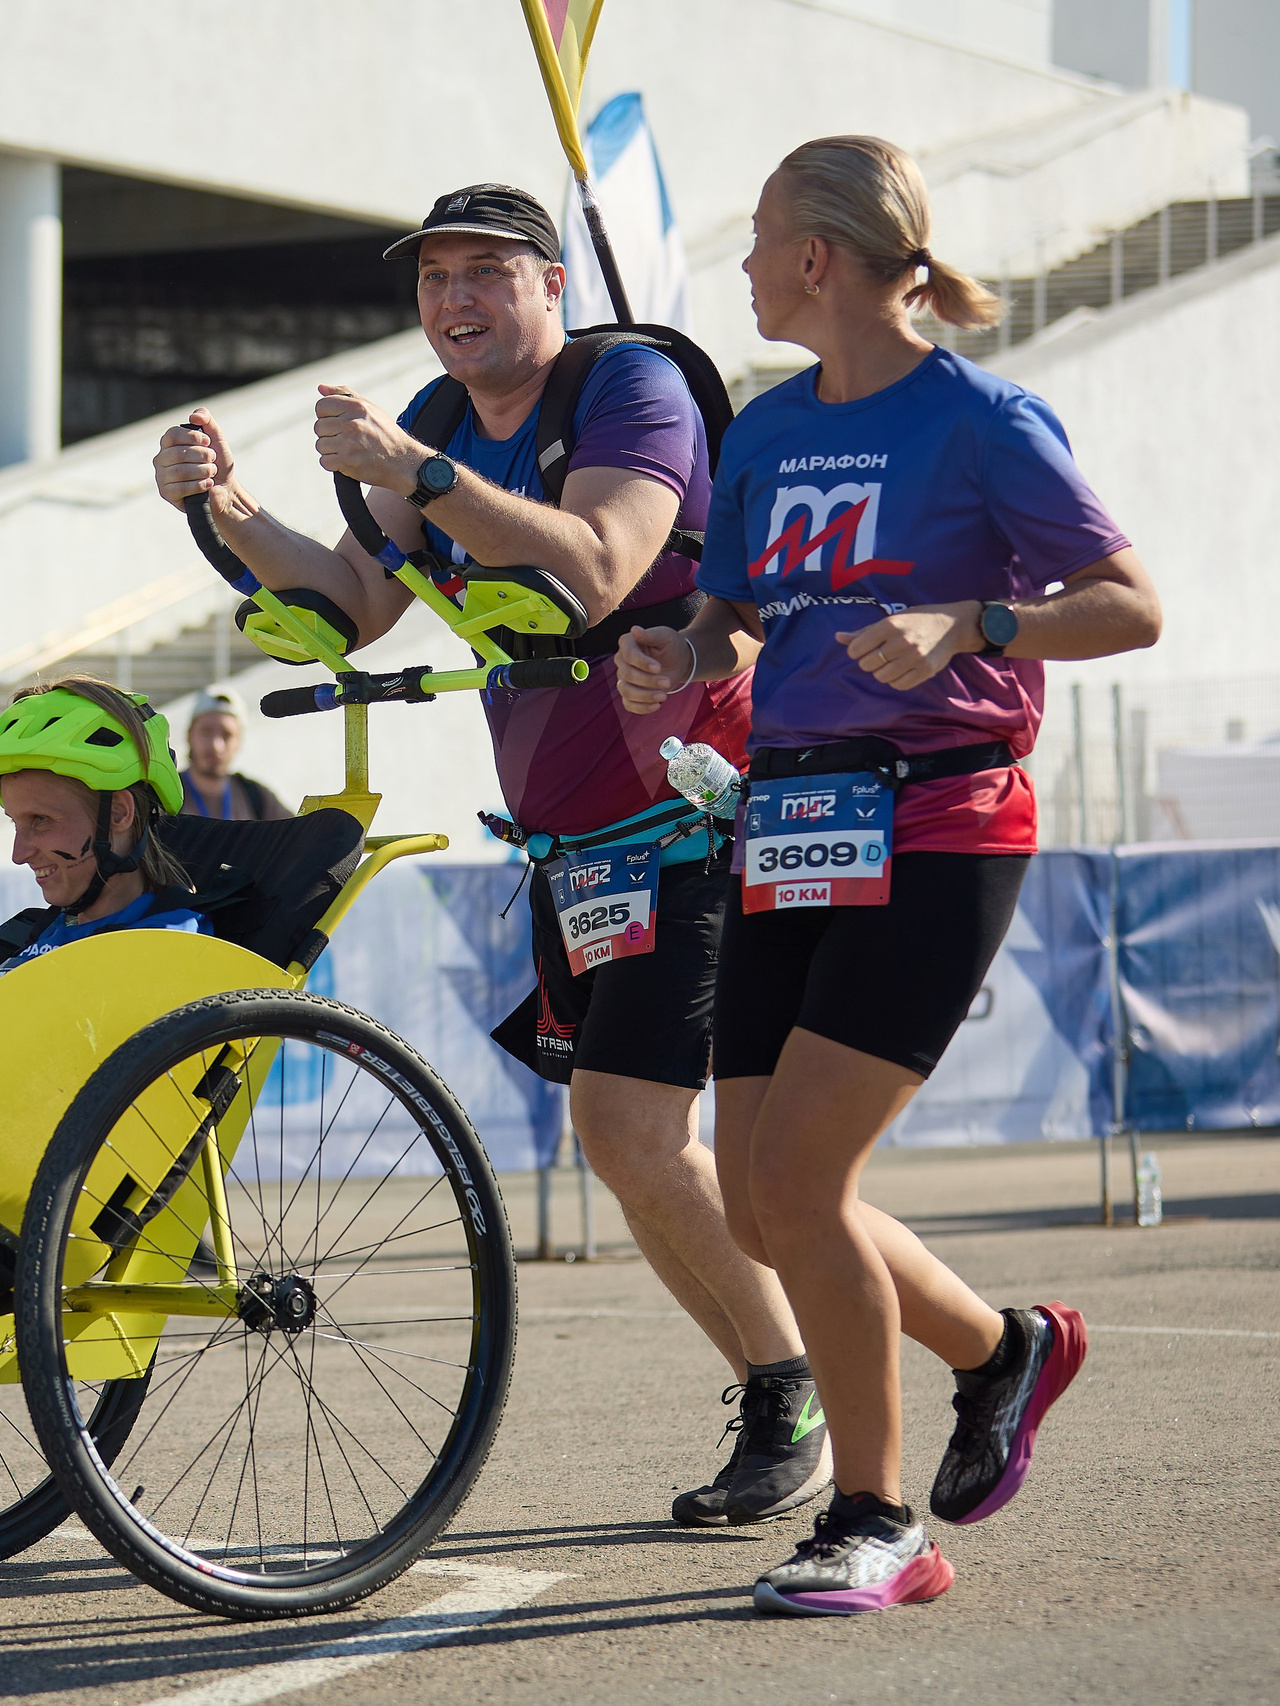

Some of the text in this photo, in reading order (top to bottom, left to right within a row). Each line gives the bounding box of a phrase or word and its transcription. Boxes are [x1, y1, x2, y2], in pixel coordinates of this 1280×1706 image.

[778, 453, 889, 474] МАРАФОН
[758, 842, 882, 873] 3609 D
[778, 889, 795, 903] 10
[568, 902, 640, 941] 3625 E
[584, 950, 593, 965] 10
[536, 1034, 574, 1052] STREIN
[359, 1048, 474, 1186] FELGEBIETER
[53, 1376, 73, 1428] CHAOYANG
